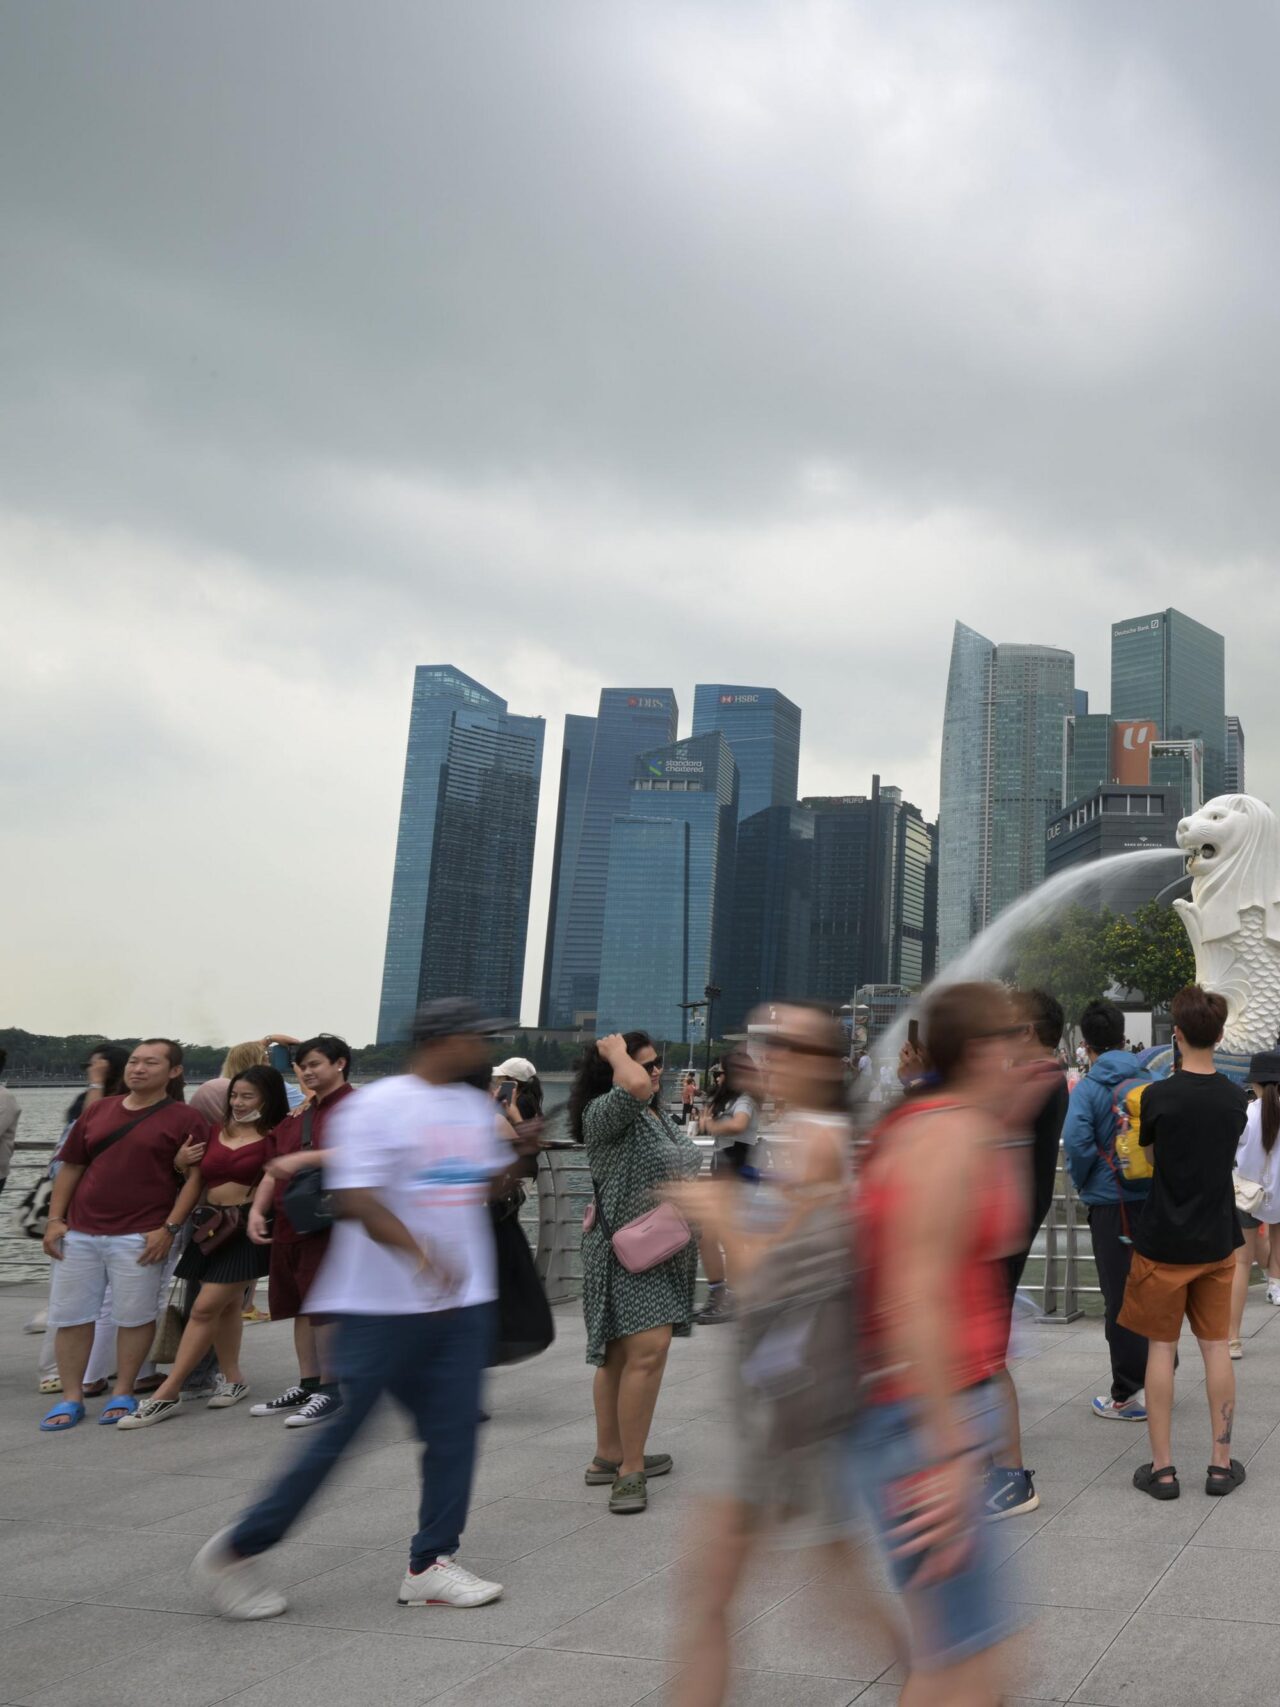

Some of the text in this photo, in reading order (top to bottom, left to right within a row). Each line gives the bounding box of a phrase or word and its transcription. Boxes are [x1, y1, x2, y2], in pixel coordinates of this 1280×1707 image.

[639, 697, 664, 708] DBS
[734, 694, 759, 703] HSBC
[665, 759, 703, 767] standard
[665, 765, 704, 773] chartered
